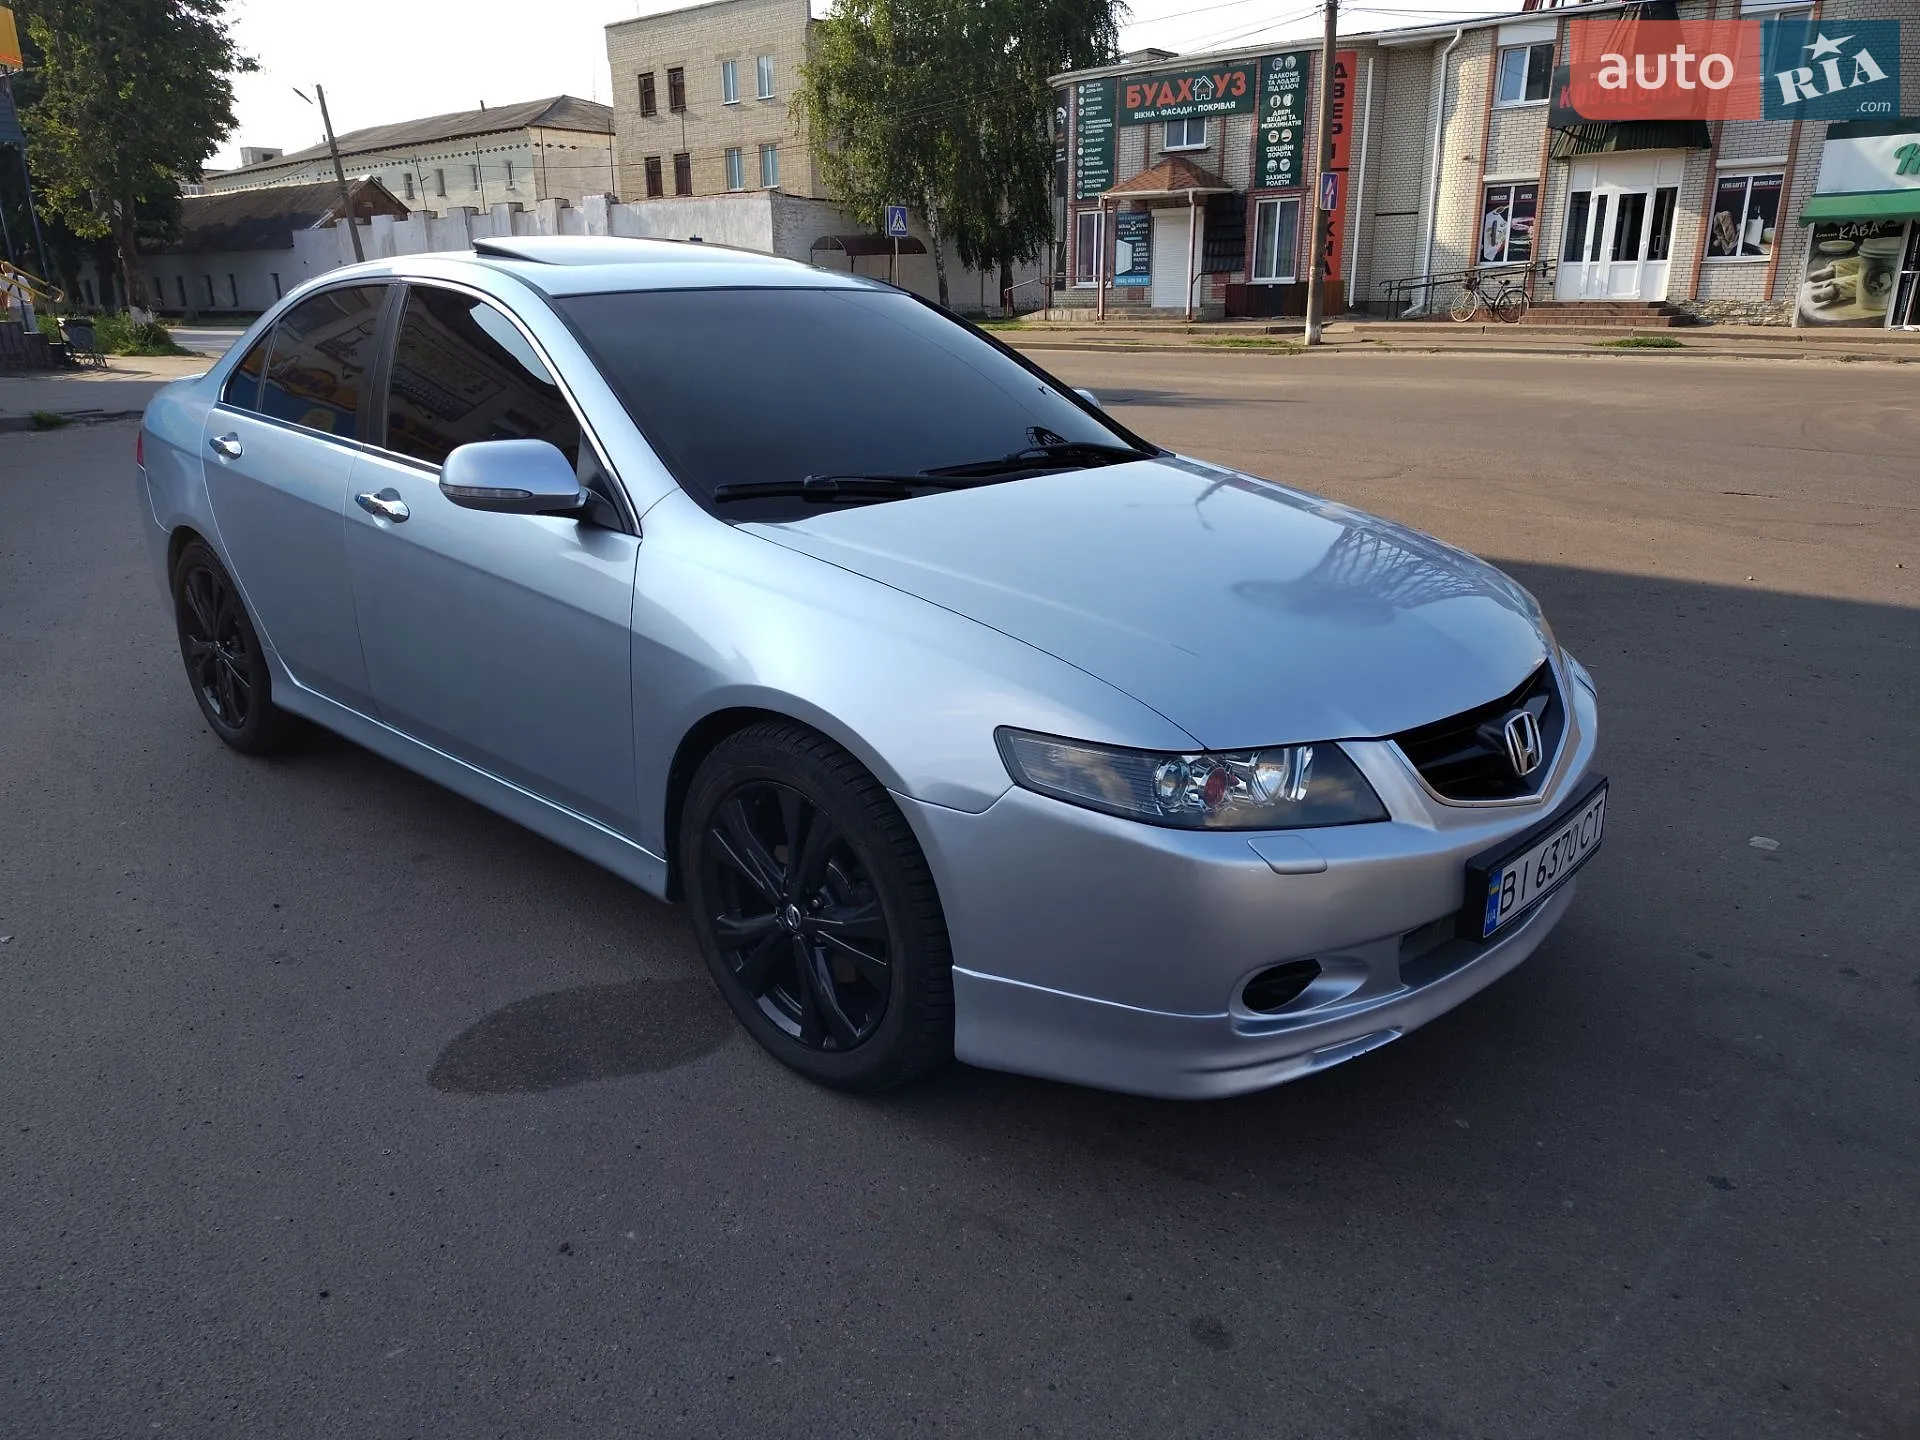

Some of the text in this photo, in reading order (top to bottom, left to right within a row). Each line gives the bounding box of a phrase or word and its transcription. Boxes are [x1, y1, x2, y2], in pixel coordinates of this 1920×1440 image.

[1269, 71, 1299, 80] БАЛКОНИ
[1134, 101, 1236, 119] ВІКНА ФАСАДИ ПОКРІВЛЯ
[1272, 109, 1291, 117] ДВЕРІ
[1265, 144, 1294, 153] СЕКЦІЙНІ
[1265, 173, 1292, 181] ЗАХИСНІ
[1266, 179, 1290, 187] РОЛЕТИ
[1838, 221, 1880, 239] КАВА
[1500, 799, 1603, 916] BI 6370 CT
